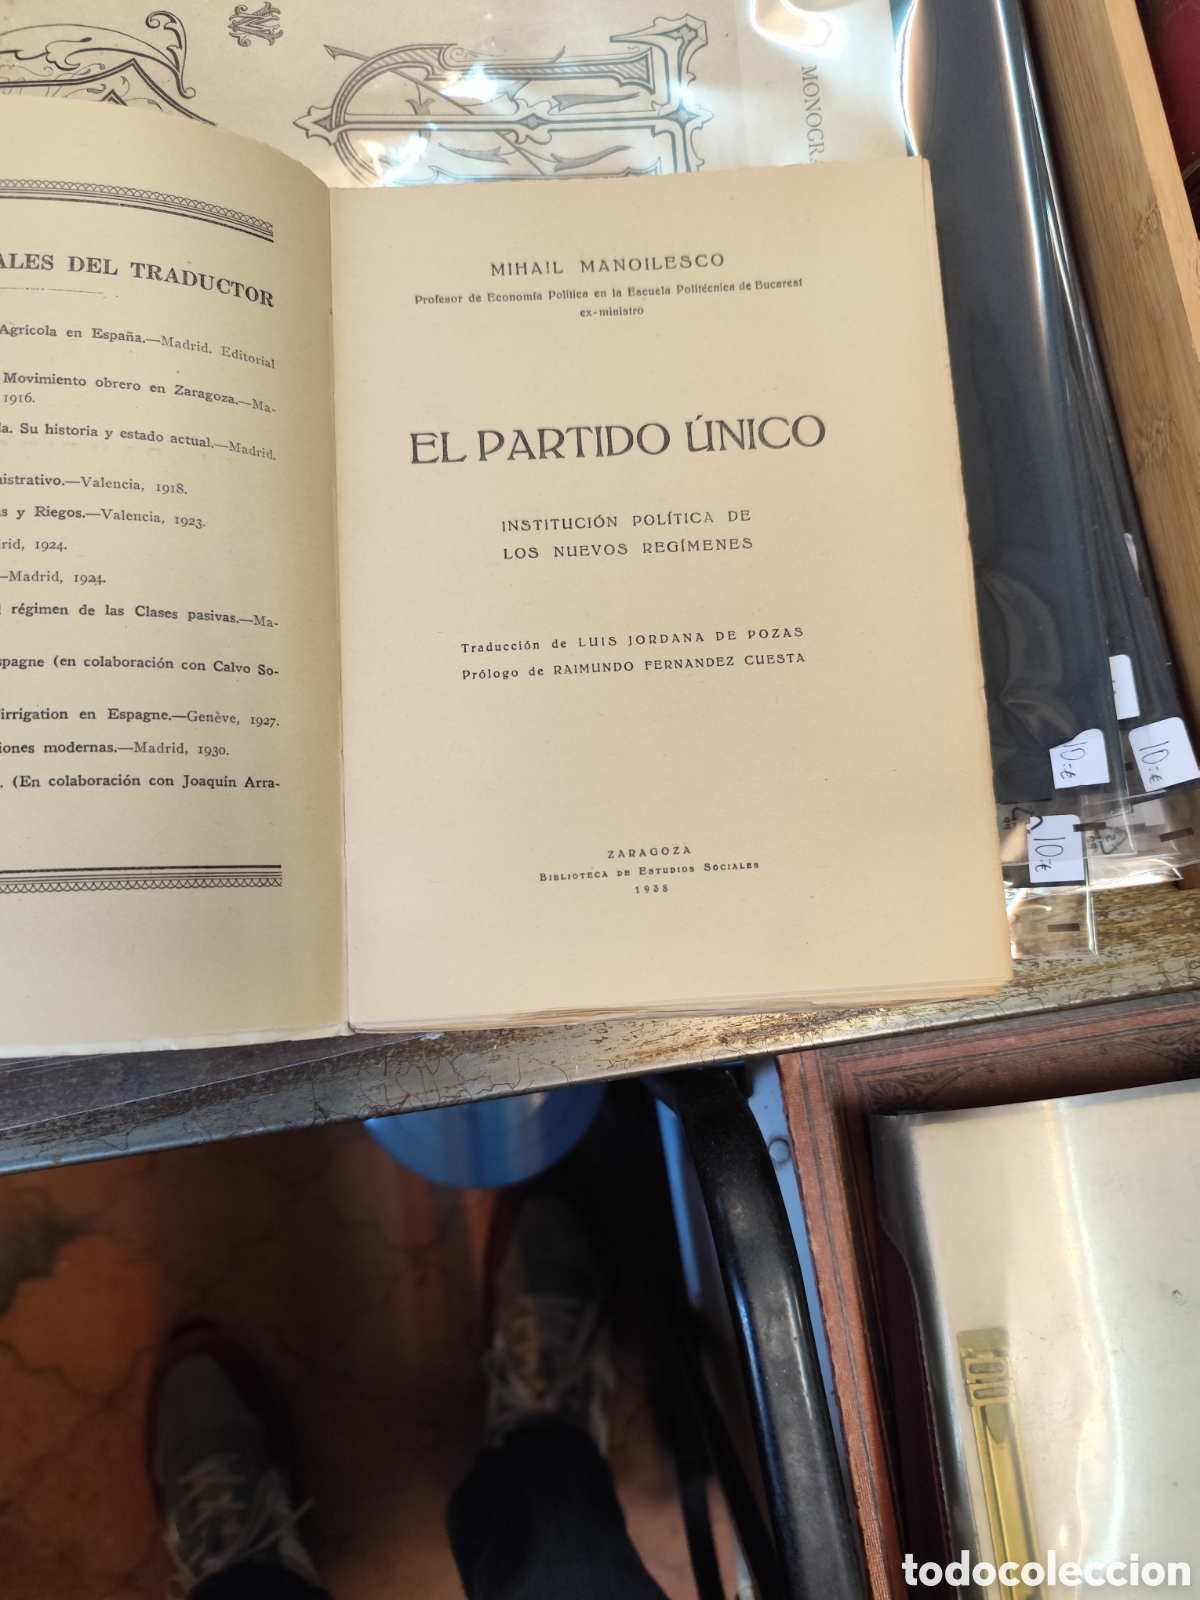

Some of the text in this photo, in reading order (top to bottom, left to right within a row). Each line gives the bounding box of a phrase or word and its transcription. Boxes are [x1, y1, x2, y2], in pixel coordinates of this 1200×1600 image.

[801, 64, 825, 162] MONOGR
[491, 254, 724, 276] MIHAIL MANOILESCO
[68, 256, 118, 275] DEL
[130, 262, 274, 307] TRADUCTOR
[415, 294, 463, 304] Profesor
[469, 293, 481, 302] de
[487, 292, 542, 302] Economía
[549, 289, 588, 300] Política
[612, 288, 621, 297] la
[628, 286, 670, 296] Escuela
[677, 283, 735, 294] Politécnica
[739, 281, 751, 290] de
[755, 278, 802, 290] Bucarest
[580, 307, 644, 317] ex-ministro
[0, 324, 57, 337] Agrícola
[221, 346, 275, 369] Editorial
[3, 372, 86, 386] Movimiento
[95, 377, 141, 391] obrero
[150, 385, 166, 393] en
[4, 392, 35, 405] 1916.
[20, 423, 38, 434] Su
[45, 423, 98, 436] historia
[105, 430, 113, 440] y
[120, 430, 164, 442] estado
[410, 414, 825, 464] EL PARTIDO ÚNICO
[156, 483, 187, 494] 1918.
[16, 510, 25, 520] y
[174, 515, 207, 530] 1923.
[502, 510, 751, 532] INSTITUCIÓN POLÍTICA DE
[0, 537, 67, 552] rid, 1924.
[503, 538, 752, 559] LOS NUEVOS REGÍMENES
[74, 574, 106, 585] 1924.
[11, 602, 69, 617] régimen
[79, 604, 95, 616] de
[105, 604, 124, 616] las
[135, 605, 178, 619] Clases
[461, 627, 803, 653] Traducción de LUIS JORDANA DE POZAS
[53, 655, 76, 668] (en
[84, 656, 174, 669] colaboración
[181, 662, 206, 671] con
[213, 660, 250, 673] Calvo
[258, 664, 279, 675] So-
[462, 653, 805, 680] Prólogo de RAIMUNDO FERNANDEZ CUESTA
[79, 711, 96, 719] en
[251, 717, 279, 728] 1927.
[198, 746, 229, 757] 1930.
[13, 774, 280, 789] (En colaboración con Joaquín Arra-
[608, 846, 690, 859] ZARAGOZA
[635, 884, 668, 894] 1938
